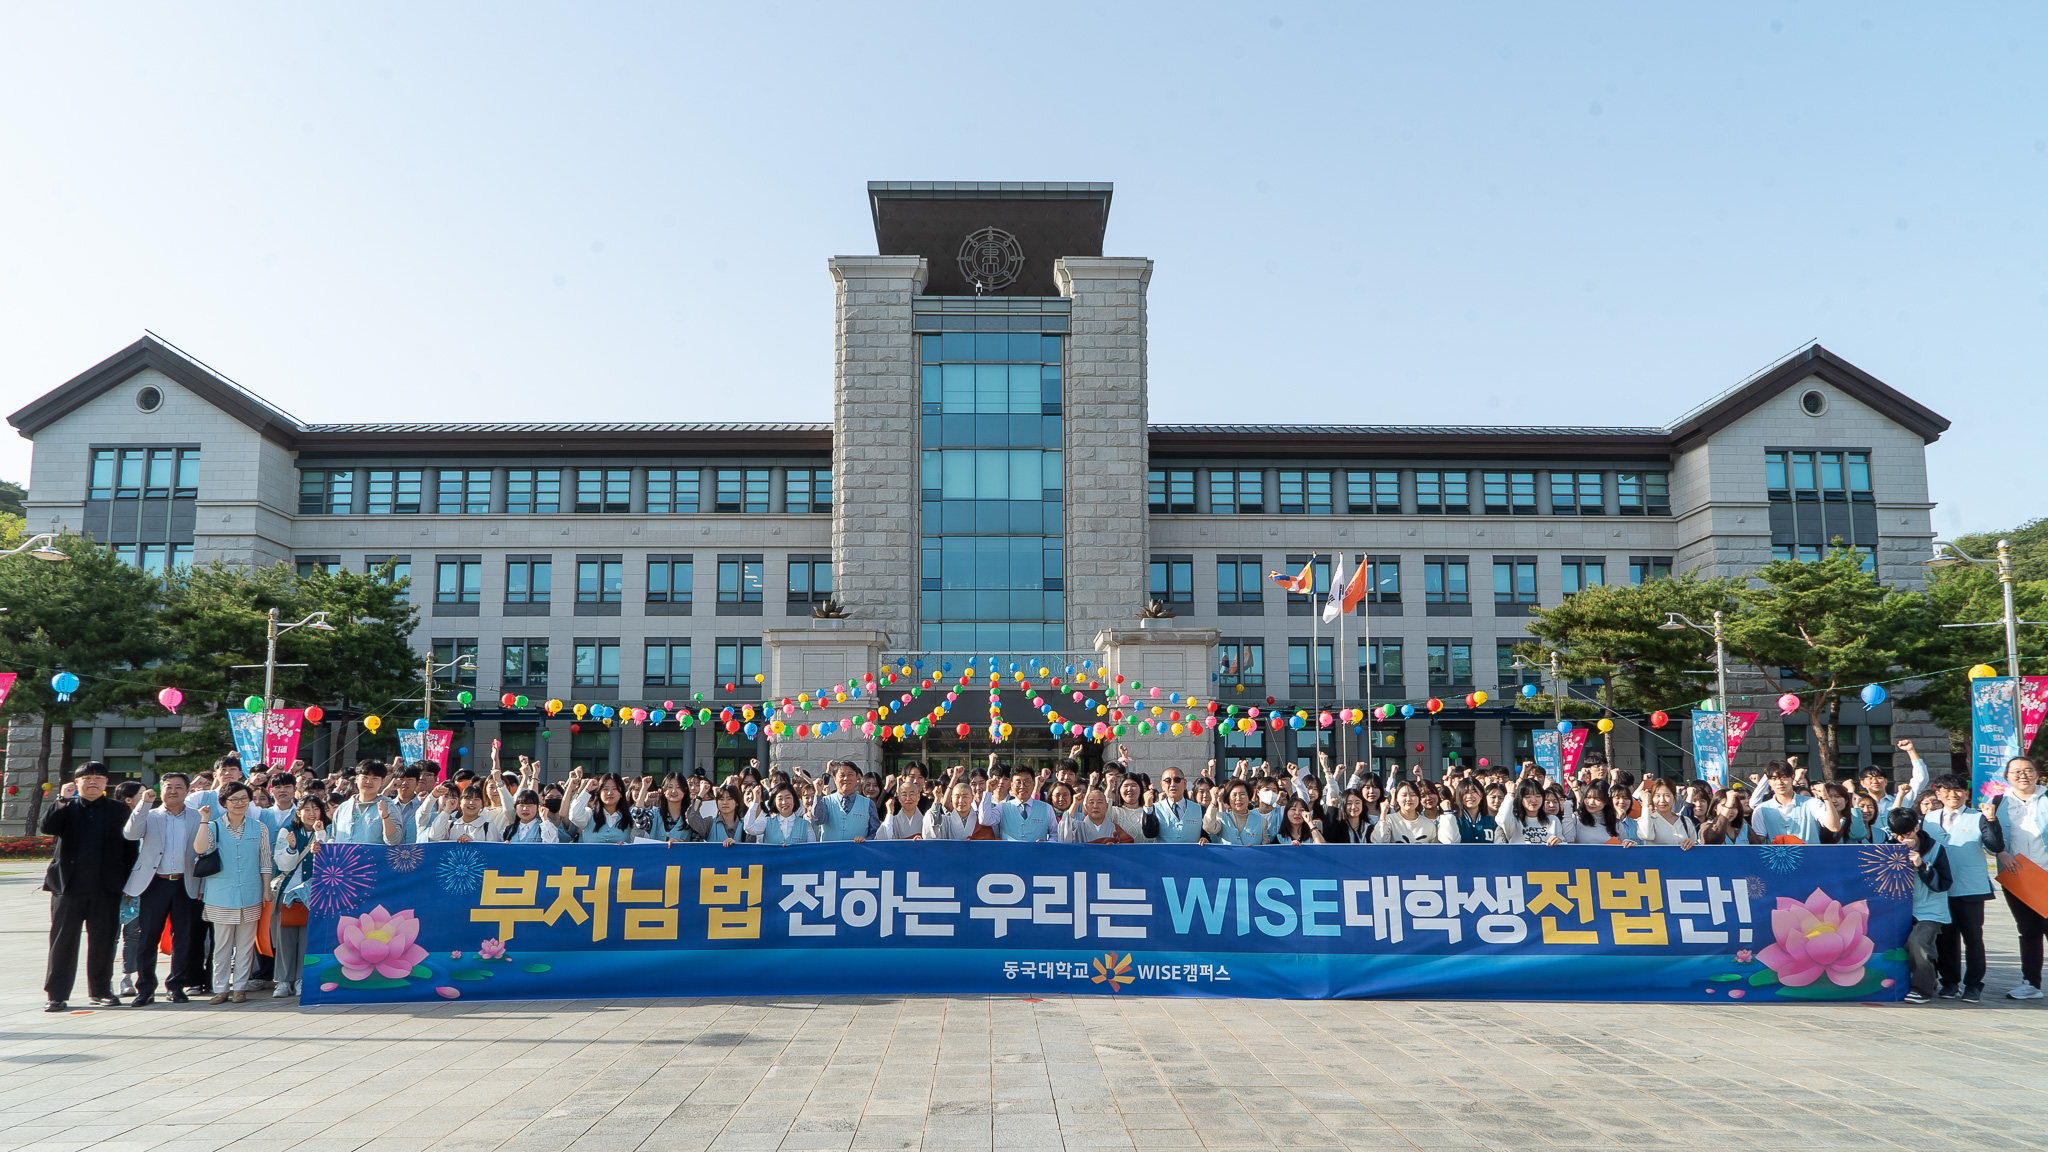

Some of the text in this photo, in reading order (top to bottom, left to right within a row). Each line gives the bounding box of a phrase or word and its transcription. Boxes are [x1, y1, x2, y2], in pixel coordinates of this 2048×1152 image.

[470, 865, 680, 942] 부처님
[700, 864, 763, 940] 법
[778, 870, 961, 939] 전하는
[970, 871, 1153, 940] 우리는
[1003, 961, 1231, 983] 동국대학교 WISE캠퍼스
